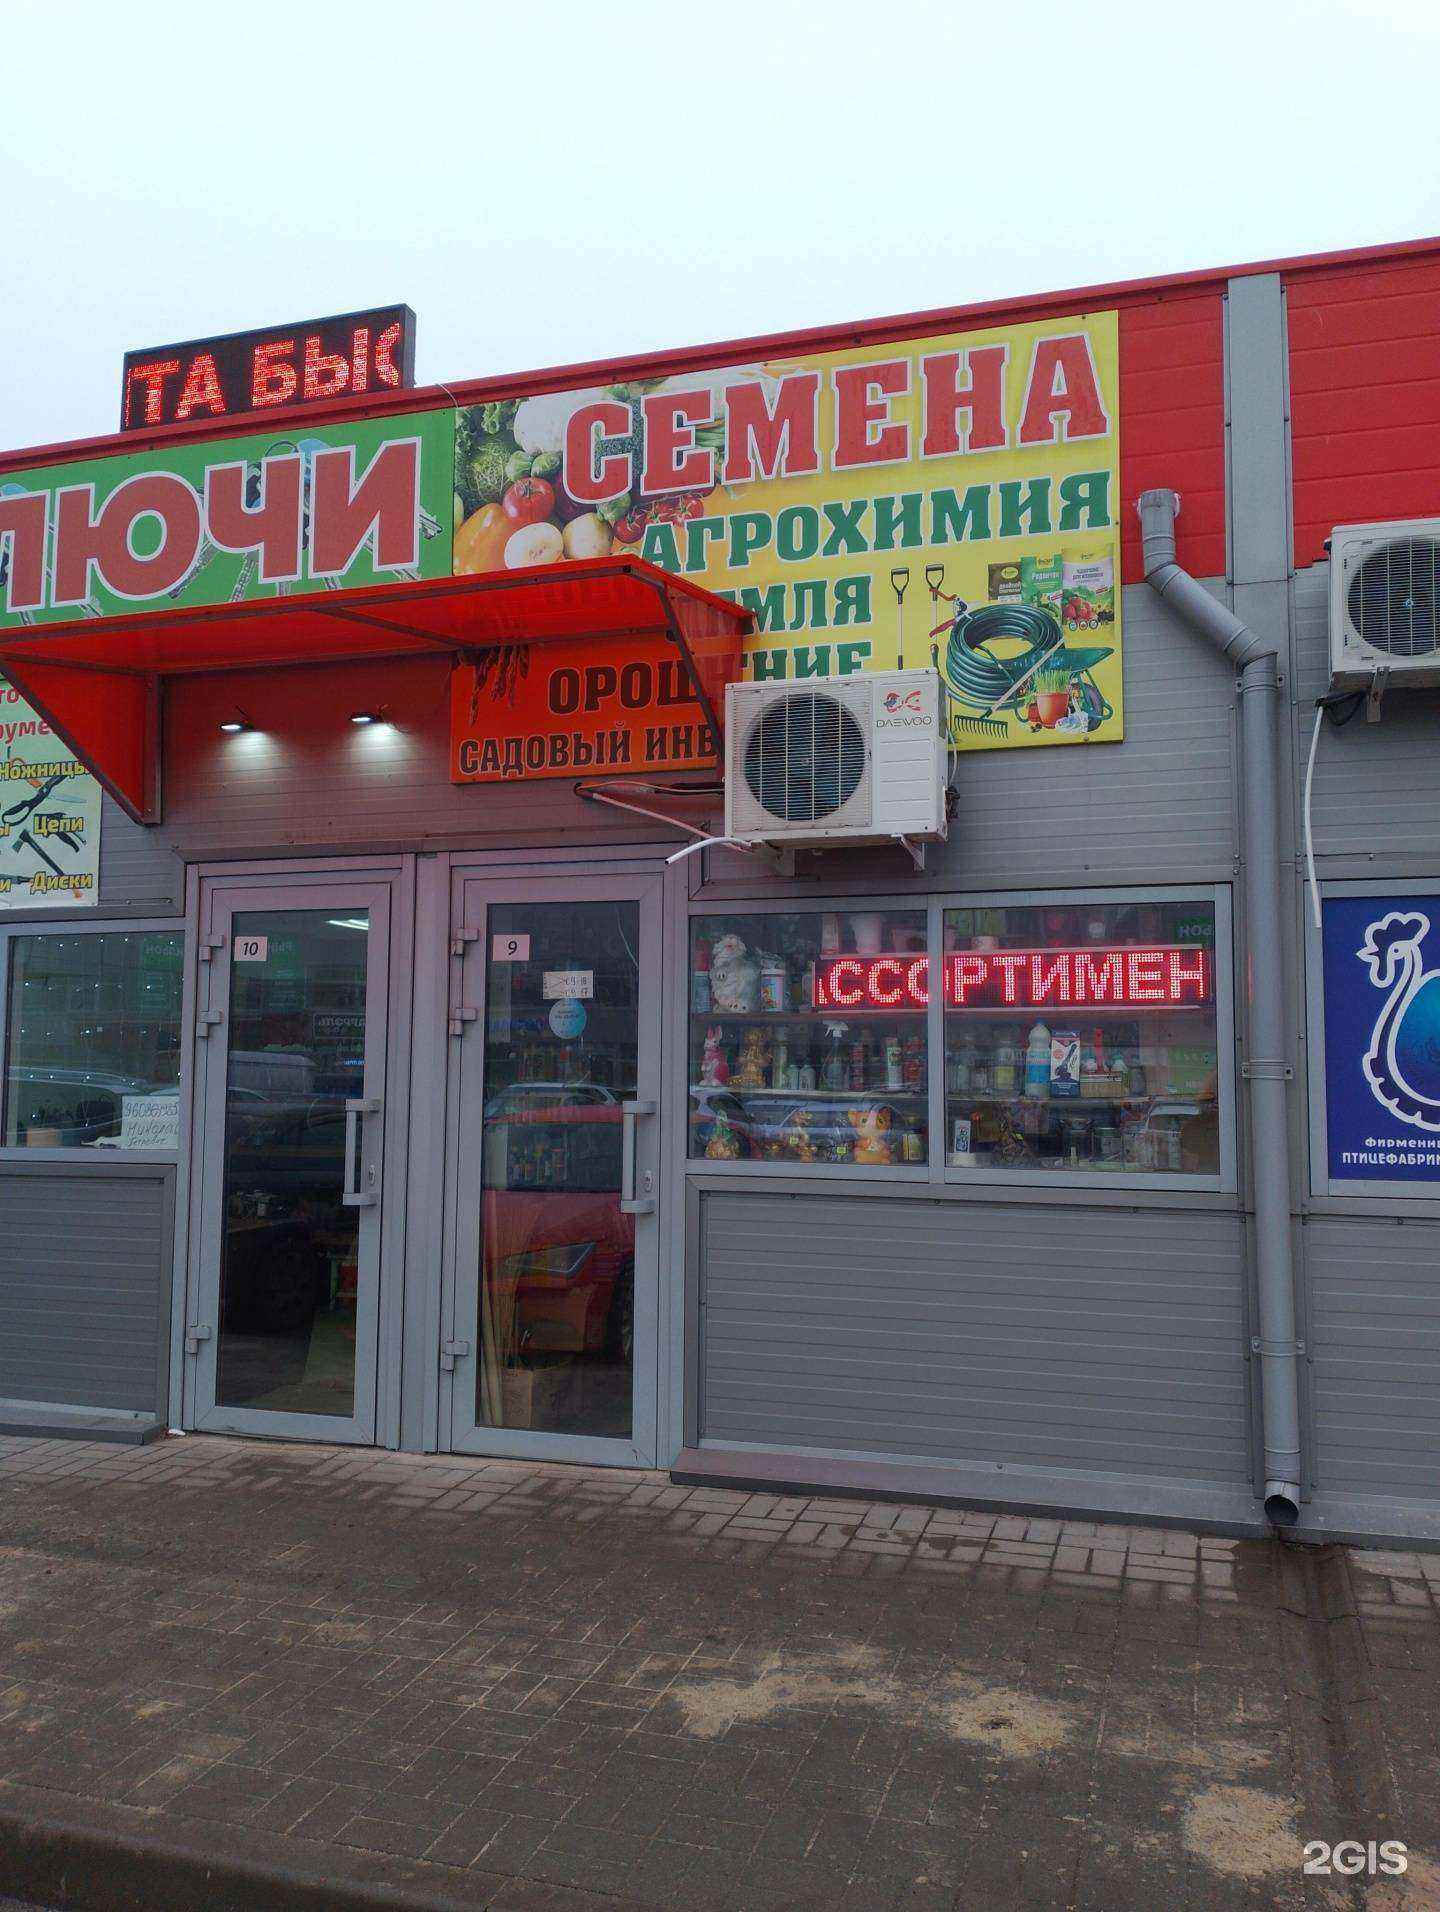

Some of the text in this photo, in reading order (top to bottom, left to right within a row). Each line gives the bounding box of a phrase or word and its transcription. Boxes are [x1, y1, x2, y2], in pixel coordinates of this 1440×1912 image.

[126, 352, 226, 425] ТА
[563, 331, 1112, 505] СЕМЕНА
[642, 472, 1112, 573] АГРОХИМИЯ
[712, 575, 872, 636] МЛЯ
[876, 716, 932, 728] DAEWOO
[460, 720, 631, 777] САДОВЫЙ
[33, 815, 84, 837] Цепи
[30, 871, 93, 895] Диски
[243, 942, 259, 957] 10
[507, 940, 518, 956] 9
